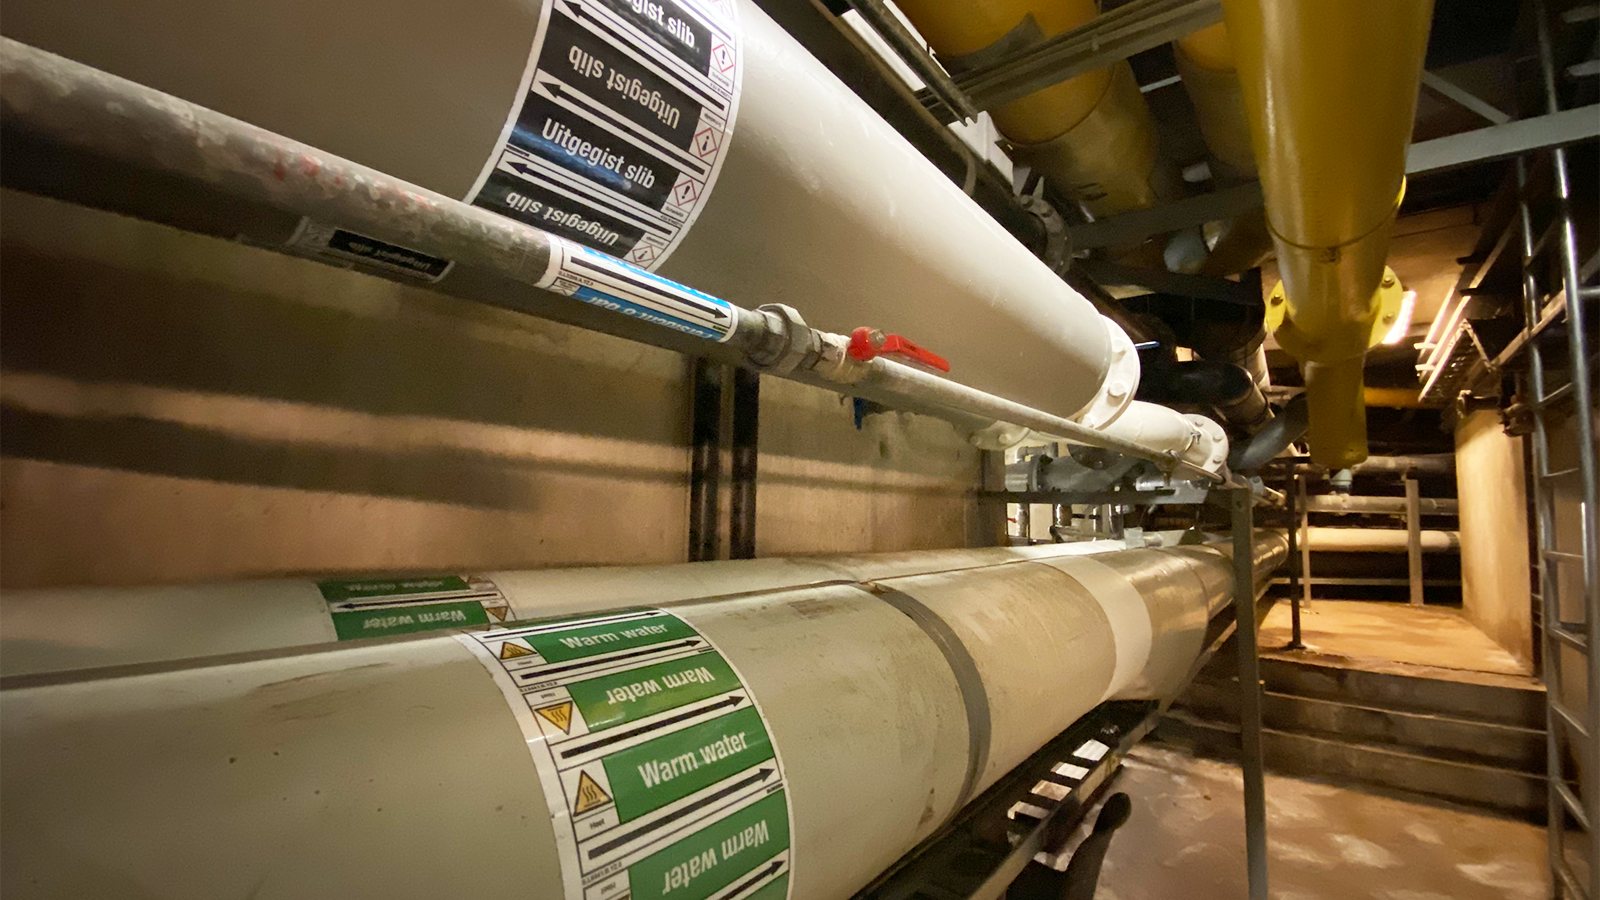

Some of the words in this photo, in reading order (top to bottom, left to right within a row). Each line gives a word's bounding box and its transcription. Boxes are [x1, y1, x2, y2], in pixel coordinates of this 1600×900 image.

[667, 17, 695, 47] slib
[568, 45, 604, 79] slib
[606, 68, 680, 130] Uitgegist
[542, 118, 626, 175] Uitgegist
[624, 164, 655, 189] slib
[505, 192, 543, 215] slib
[543, 207, 620, 247] Uitgegist
[363, 614, 414, 629] water
[418, 609, 467, 623] Warm
[558, 631, 619, 650] Warm
[623, 623, 669, 639] water
[605, 679, 662, 706] water
[662, 666, 715, 692] Warm
[638, 752, 698, 789] Warm
[699, 731, 748, 763] water
[721, 820, 770, 860] Warm
[662, 848, 717, 895] water
